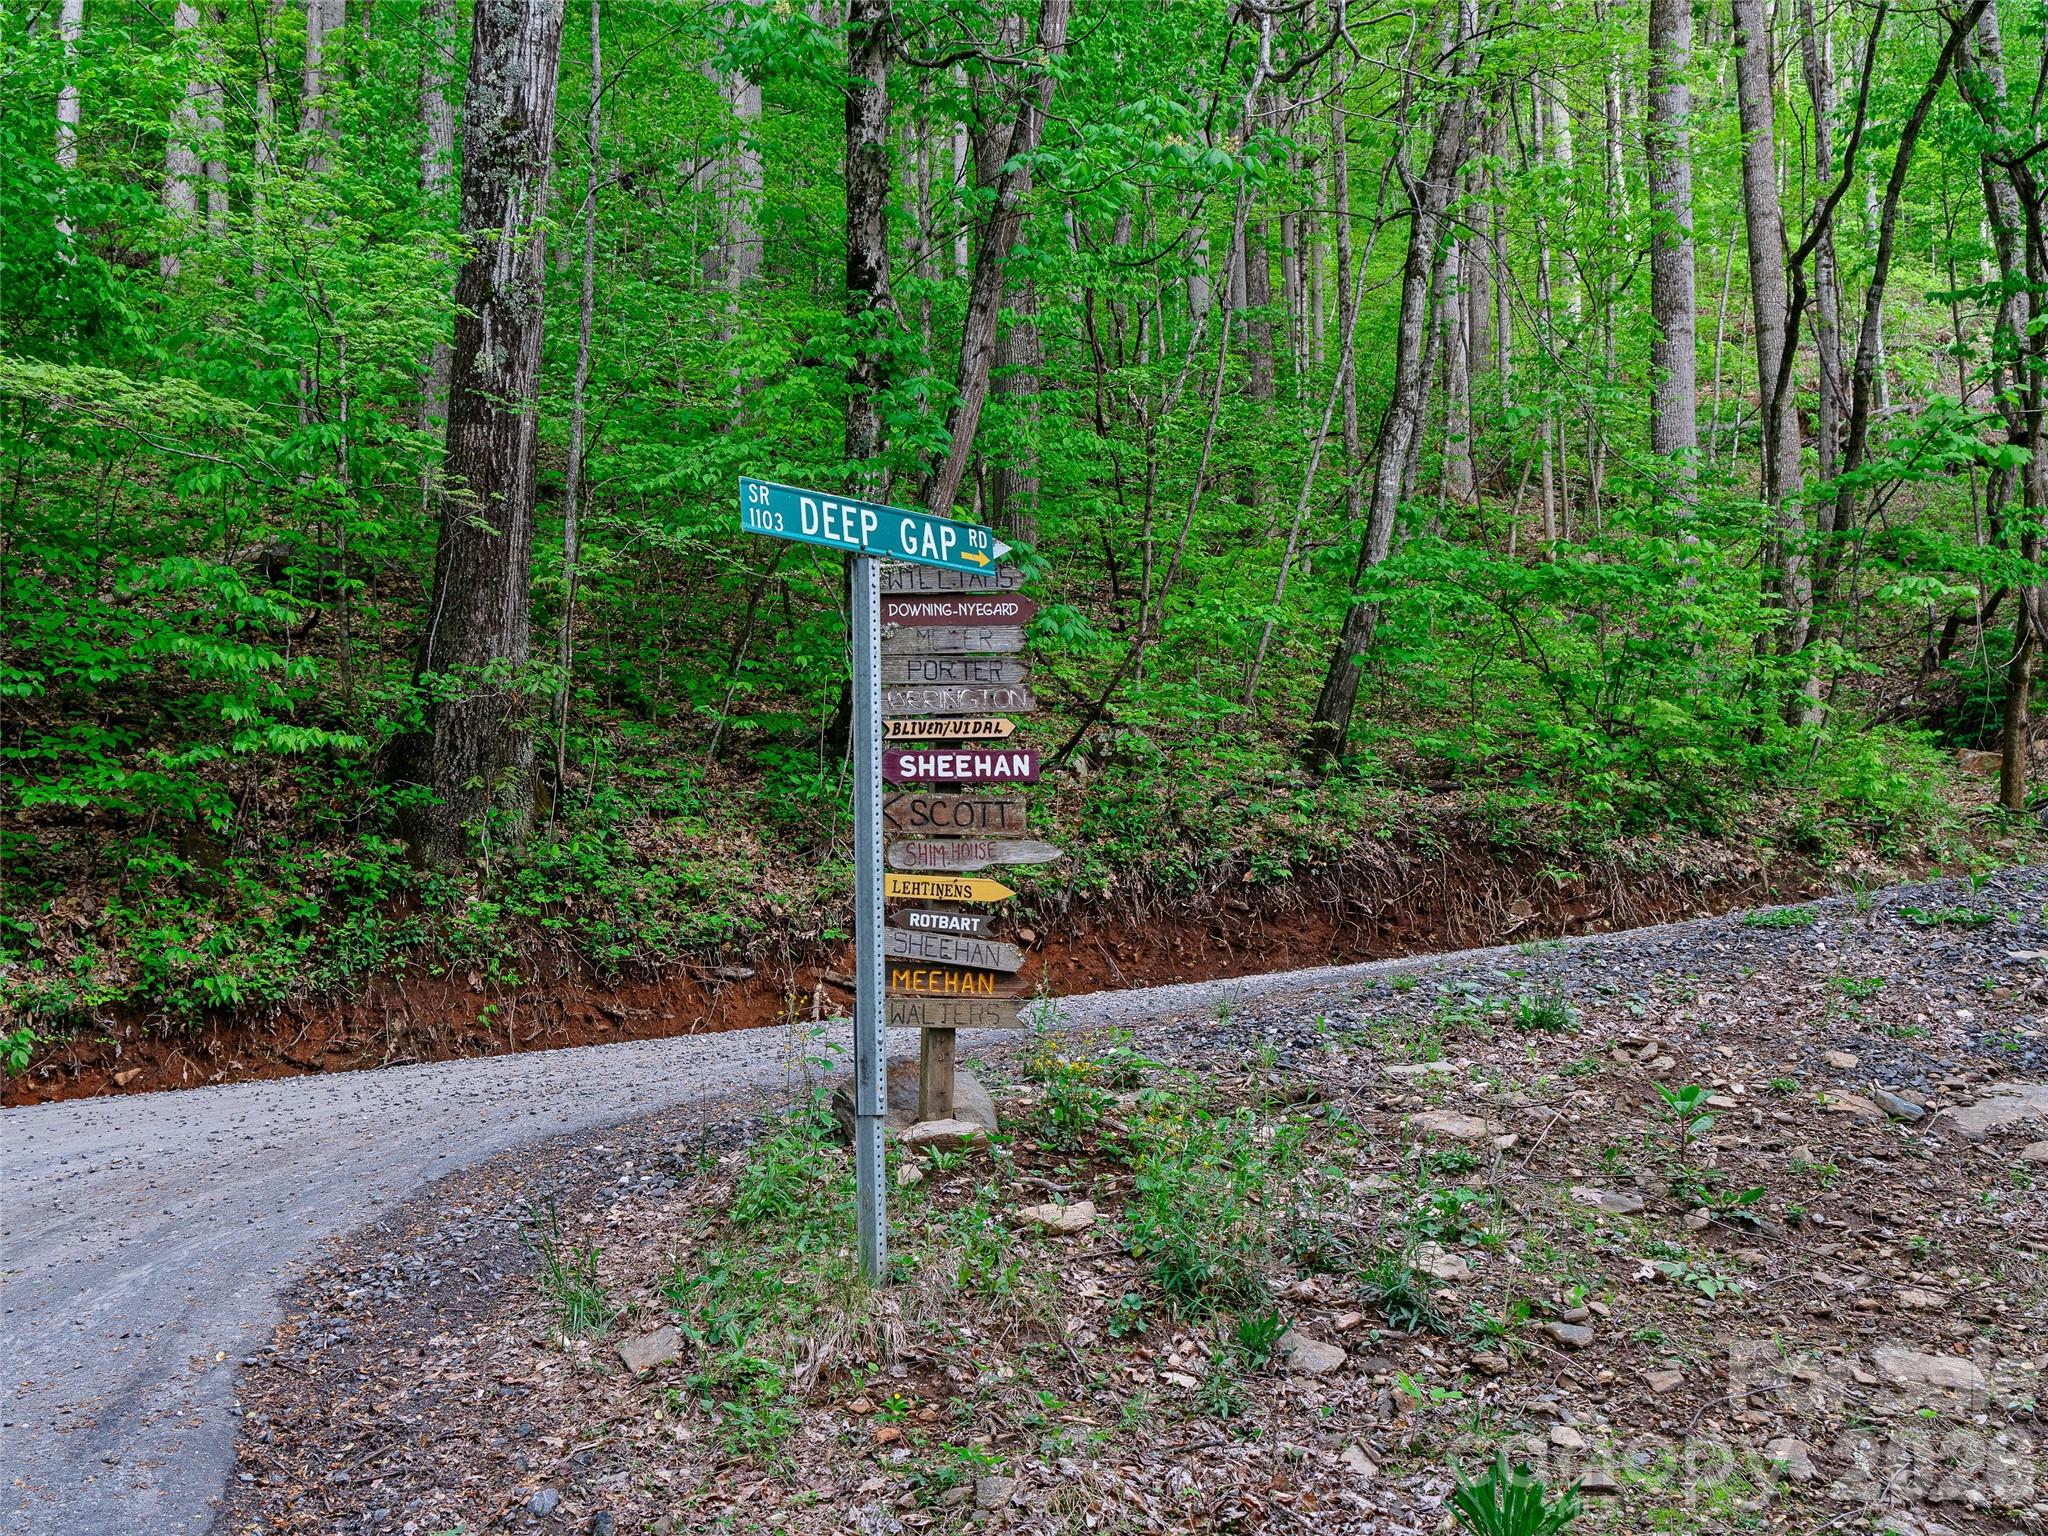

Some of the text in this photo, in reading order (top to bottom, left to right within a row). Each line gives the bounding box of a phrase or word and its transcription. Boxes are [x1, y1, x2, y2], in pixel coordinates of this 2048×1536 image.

[749, 484, 770, 506] SR
[749, 507, 784, 532] 1103
[800, 496, 988, 561] DEEP GAP RD
[888, 603, 1018, 617] DOWNING-NYEGARD
[907, 660, 1003, 681] PORTER
[899, 754, 1030, 777] SHEEHAN
[910, 801, 1013, 828] SCOTT
[904, 841, 997, 867] SHIM HOUSE
[909, 913, 980, 931] ROTBART
[893, 932, 1000, 967] SHEEHAN
[892, 969, 995, 995] MEEHAN
[890, 1002, 1000, 1025] WALTERS
